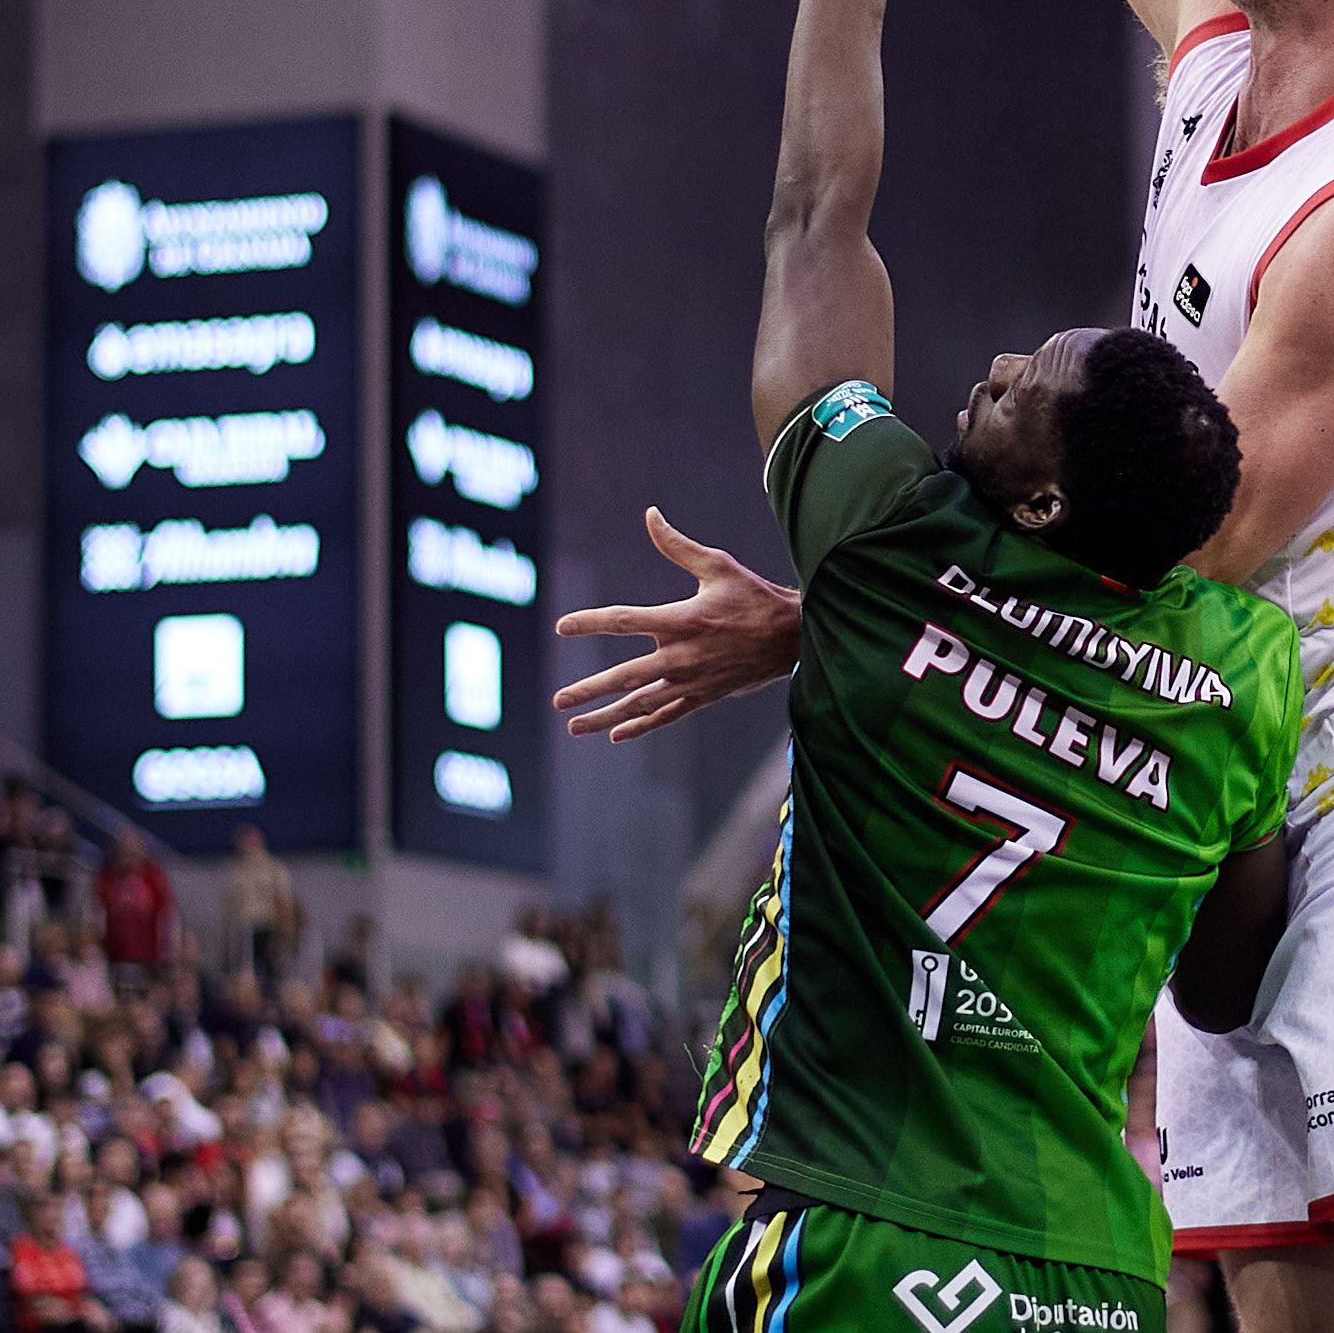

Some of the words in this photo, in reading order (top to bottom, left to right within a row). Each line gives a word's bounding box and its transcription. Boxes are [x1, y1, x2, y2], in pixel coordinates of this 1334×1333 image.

[903, 623, 1171, 811] PULEVA
[923, 768, 1069, 944] 7
[953, 1022, 991, 1036] CAPITAL
[950, 1035, 987, 1048] CIUDAD
[1170, 1165, 1204, 1181] Vella
